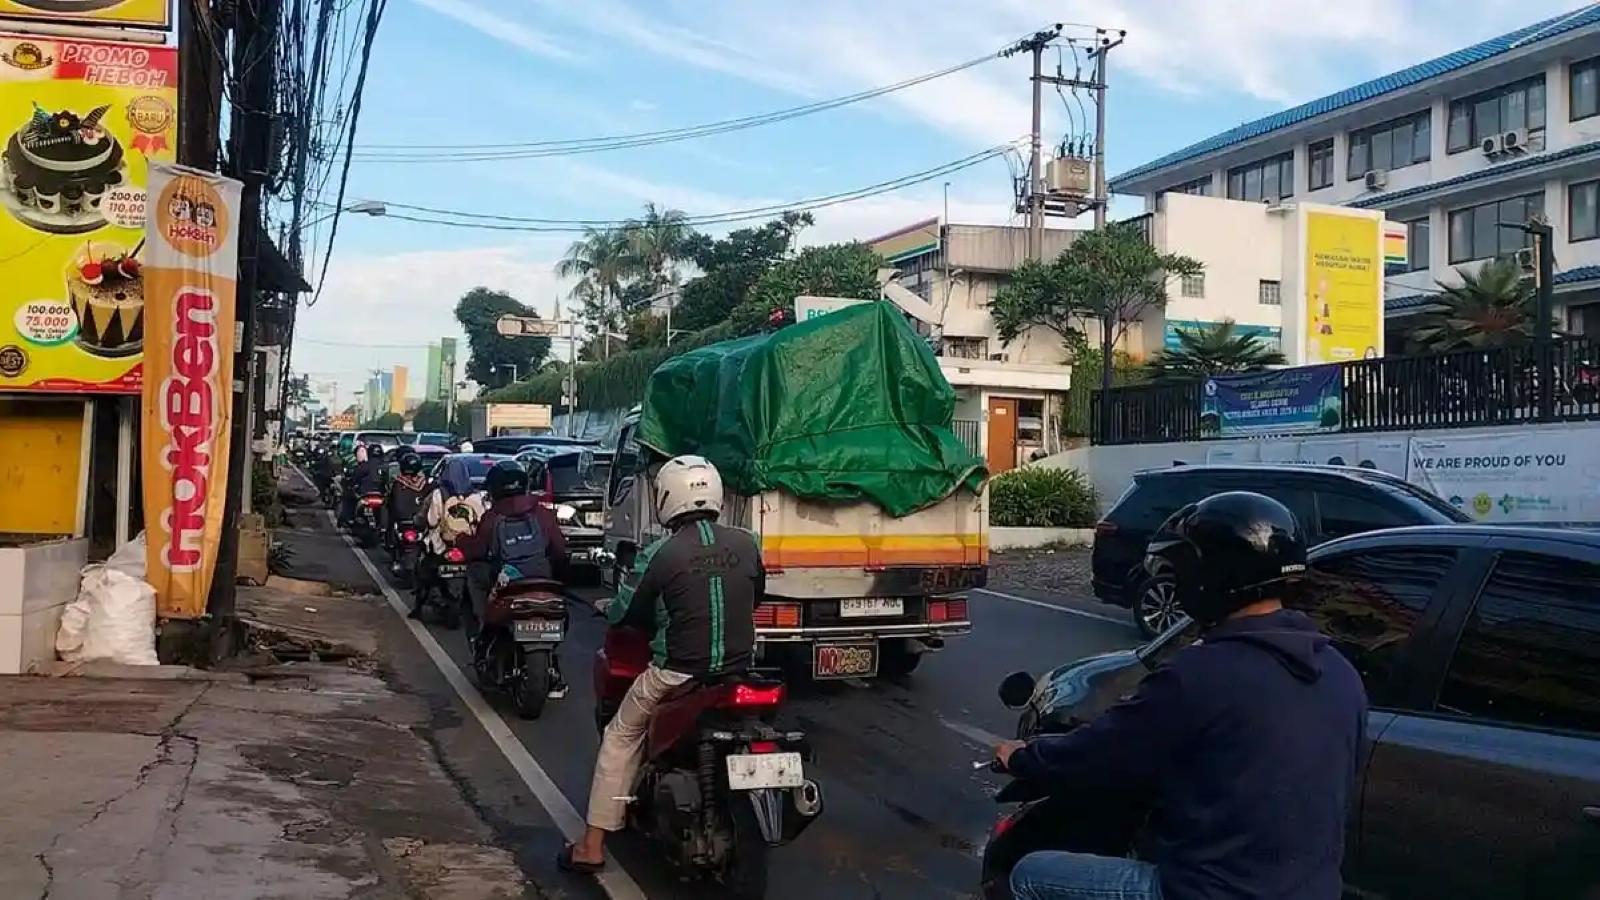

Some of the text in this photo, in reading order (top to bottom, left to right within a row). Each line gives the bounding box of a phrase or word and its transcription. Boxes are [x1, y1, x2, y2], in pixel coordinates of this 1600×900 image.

[61, 43, 149, 68] PROMO
[84, 66, 168, 87] HEBOH
[27, 304, 70, 315] 100.000
[25, 315, 69, 327] 75.000
[1414, 454, 1566, 469] WE ARE PROUD OF YOU
